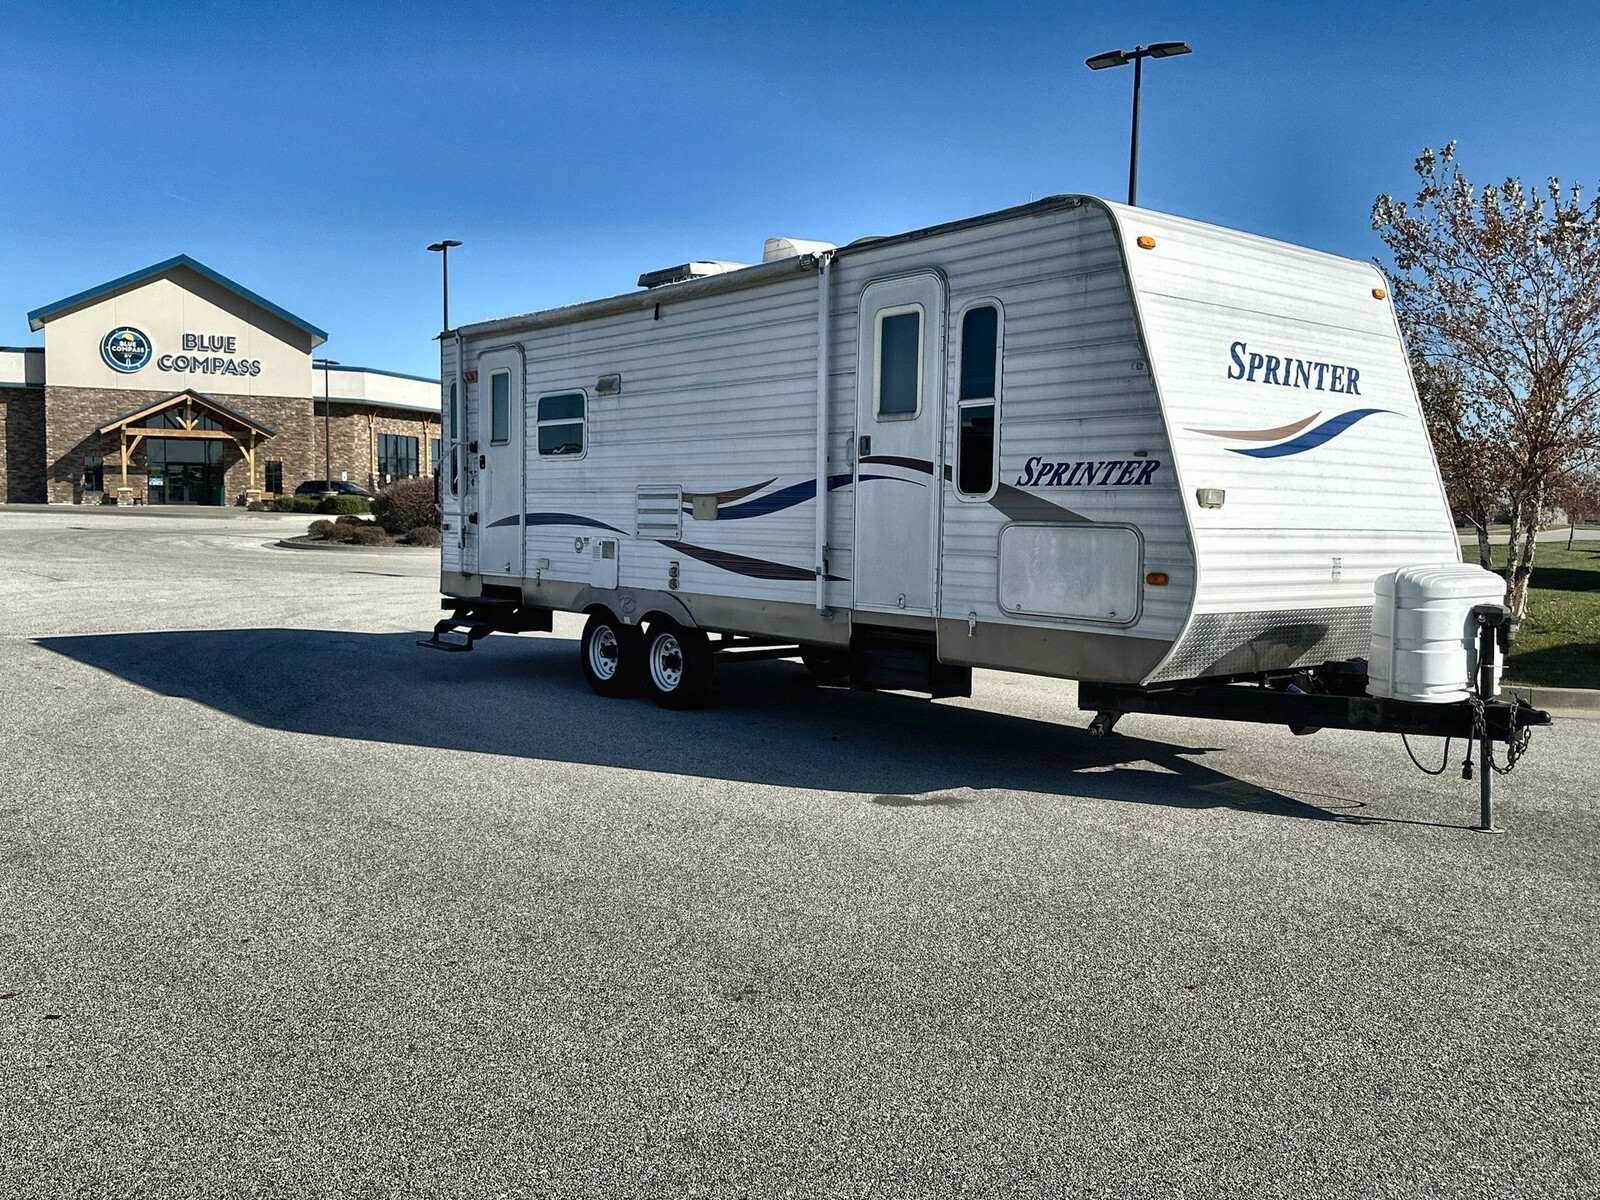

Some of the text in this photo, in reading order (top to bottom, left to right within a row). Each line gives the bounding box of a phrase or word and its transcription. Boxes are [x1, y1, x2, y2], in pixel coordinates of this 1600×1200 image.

[182, 333, 236, 353] BLUE
[157, 354, 261, 377] COMPASS
[1227, 341, 1361, 395] SPRINTER
[1015, 456, 1161, 487] SPRINTER
